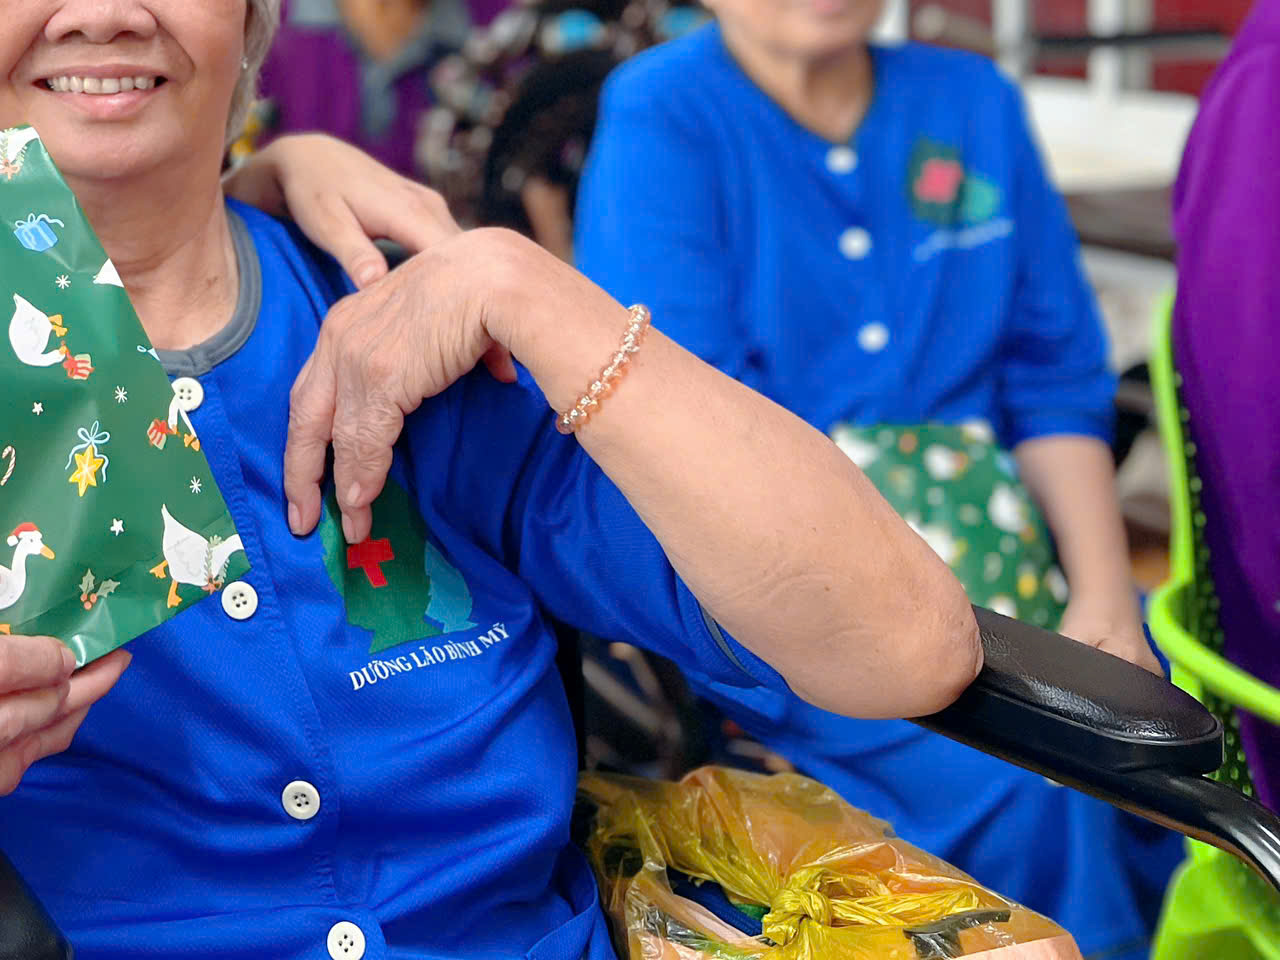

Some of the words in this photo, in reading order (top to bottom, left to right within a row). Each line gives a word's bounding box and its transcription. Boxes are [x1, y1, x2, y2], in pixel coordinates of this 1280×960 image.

[349, 656, 413, 690] DƯỠNG
[409, 646, 446, 668] LÃO
[444, 640, 483, 660] BÌNH
[477, 622, 509, 649] MỸ
